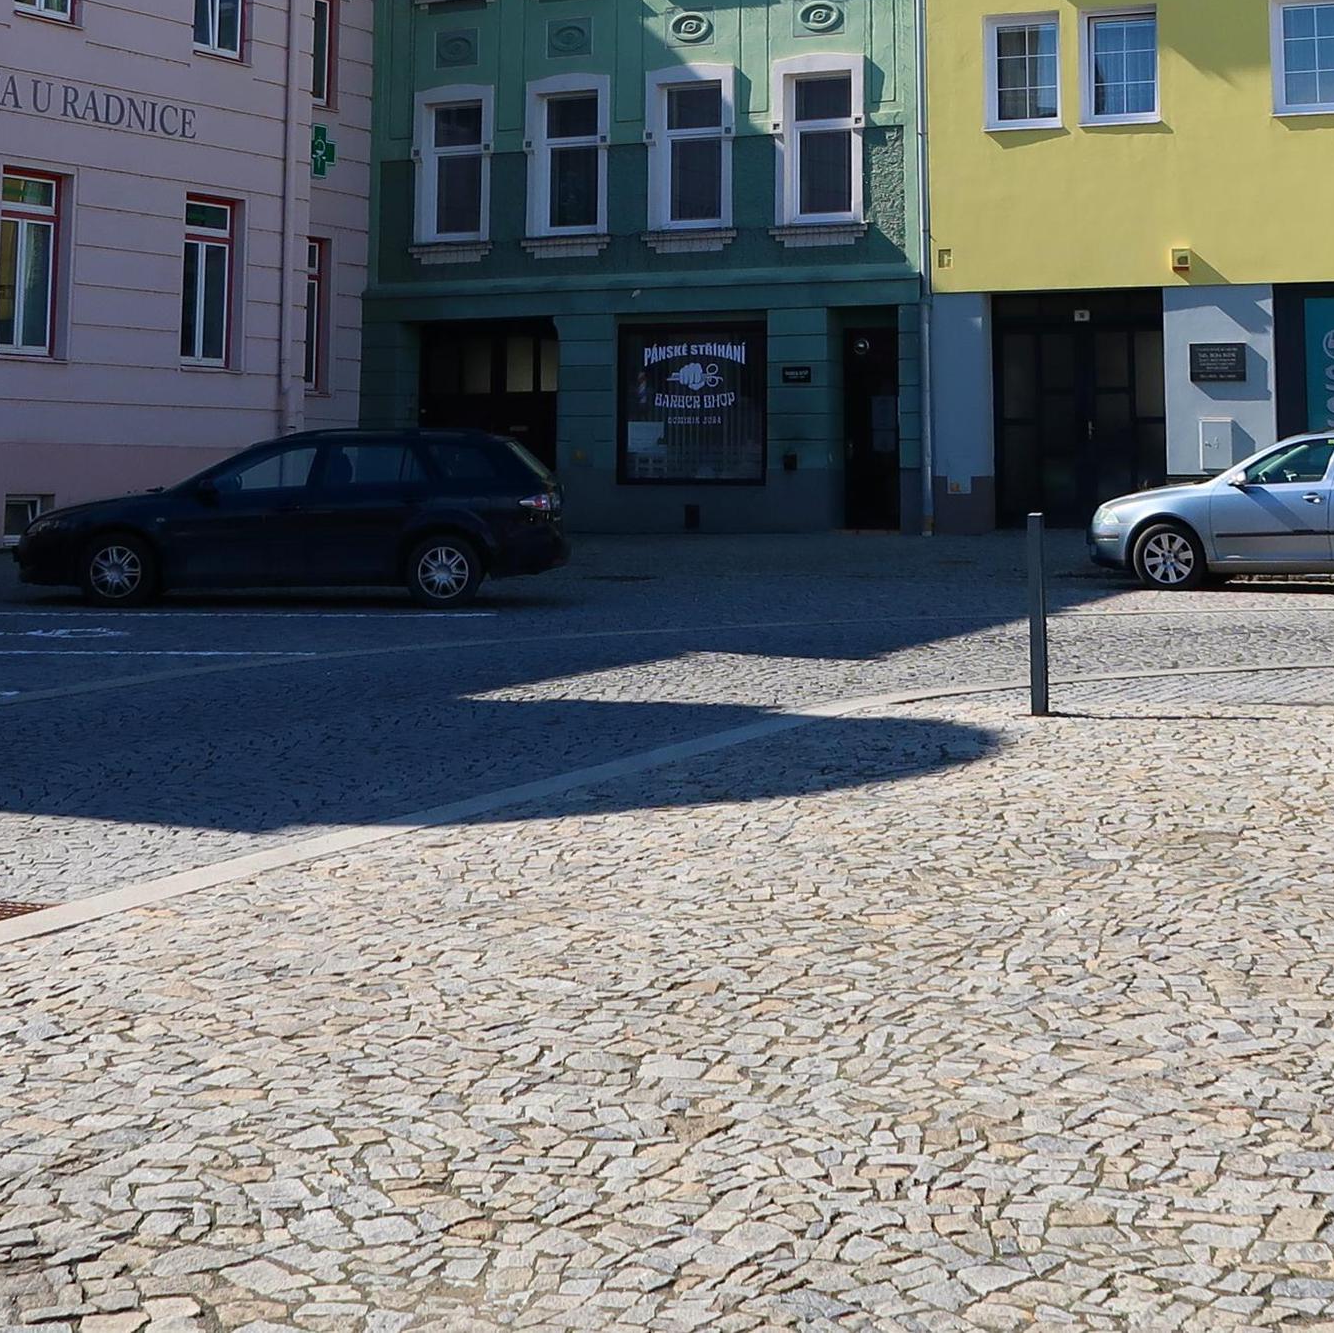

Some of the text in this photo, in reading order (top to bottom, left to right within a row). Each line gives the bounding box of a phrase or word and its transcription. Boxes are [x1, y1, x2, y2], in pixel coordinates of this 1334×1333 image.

[32, 78, 53, 113] U
[61, 85, 197, 139] RADNICE
[644, 342, 746, 367] PÁNSKÉ STŘÍHÁNÍ
[654, 392, 736, 409] BARBER SHOP
